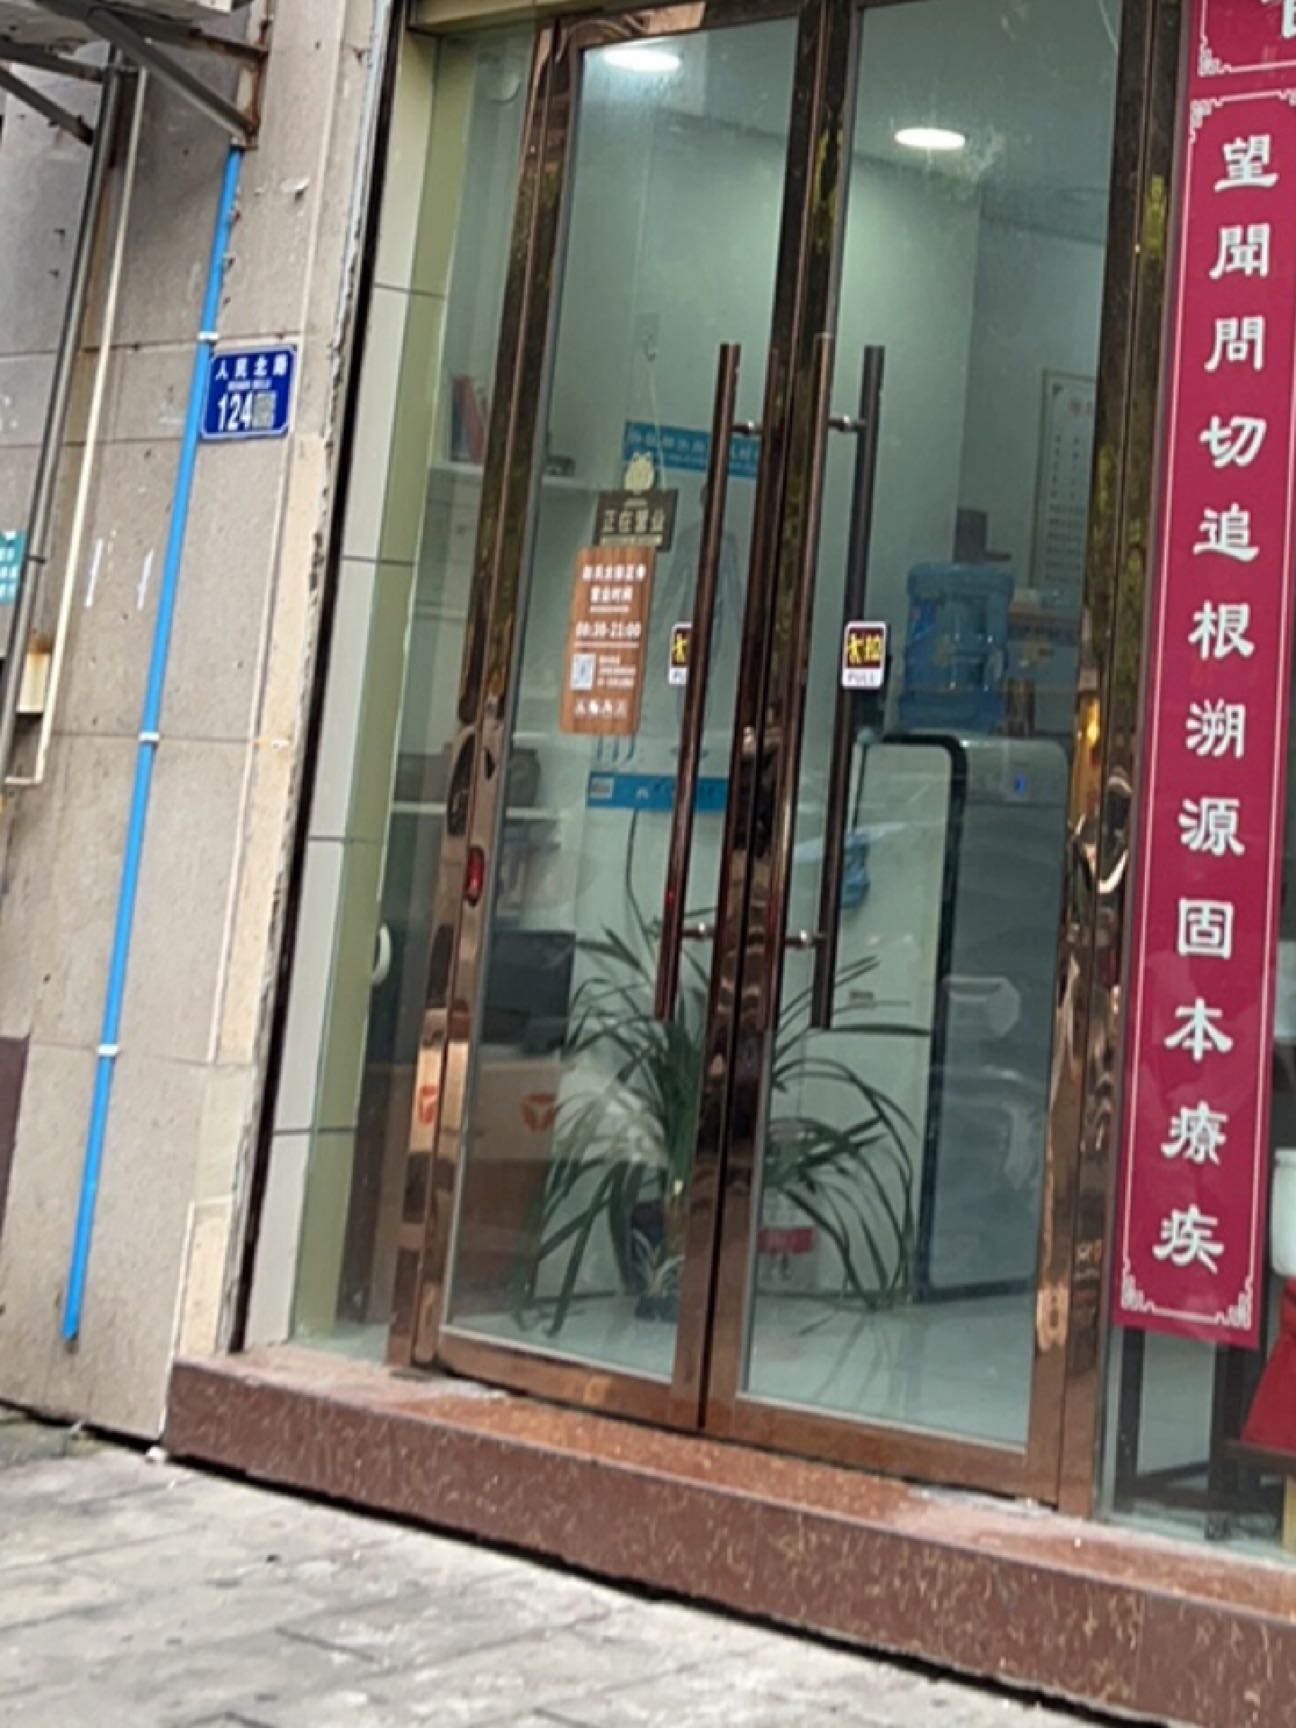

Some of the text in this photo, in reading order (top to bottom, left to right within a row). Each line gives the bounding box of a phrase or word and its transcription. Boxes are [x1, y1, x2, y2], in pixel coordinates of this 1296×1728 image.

[217, 392, 253, 432] 124
[1152, 133, 1280, 1274] 望聞問切追根溯源固本療疾
